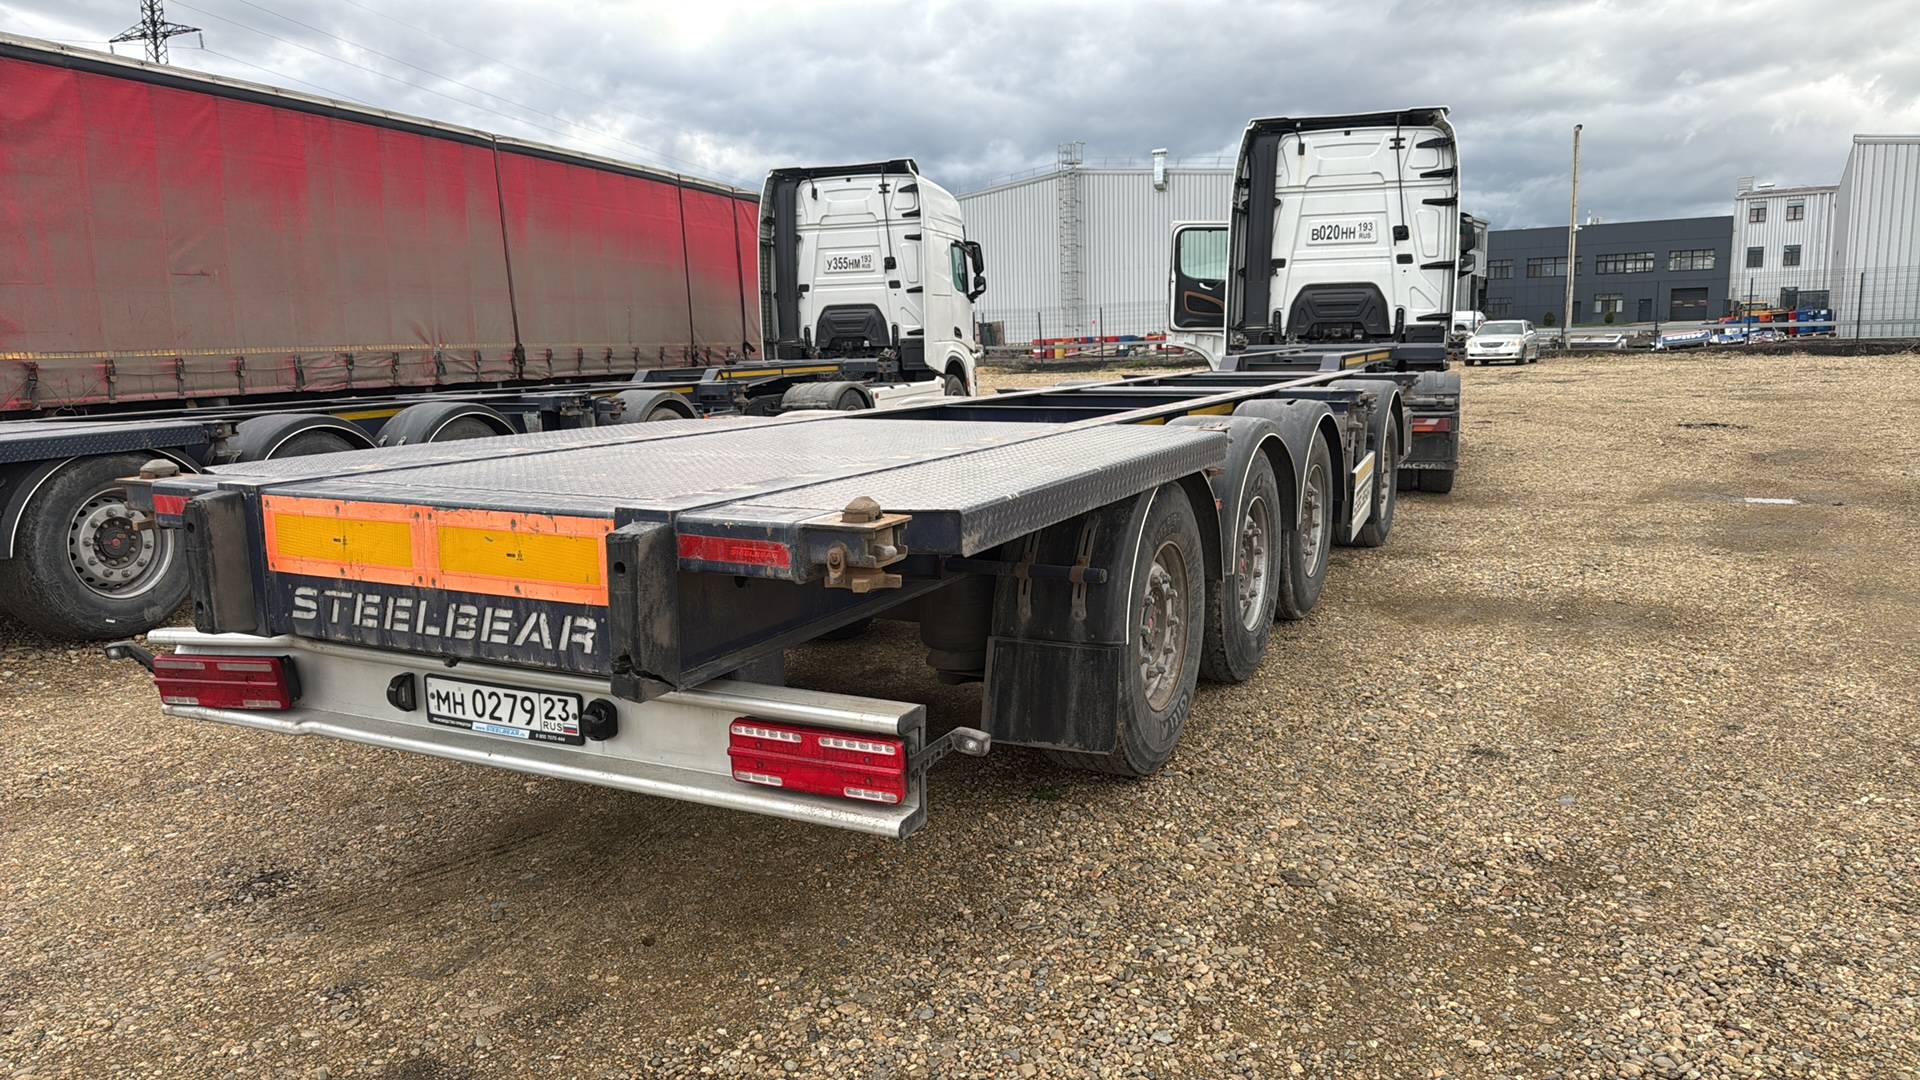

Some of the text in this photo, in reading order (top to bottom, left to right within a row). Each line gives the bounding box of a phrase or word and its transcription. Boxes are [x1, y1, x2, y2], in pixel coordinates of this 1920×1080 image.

[1311, 222, 1373, 241] В020НН 193
[827, 256, 860, 270] У355НМ
[291, 586, 597, 654] STEELBEAR
[435, 688, 570, 726] МН 0279 23
[543, 721, 563, 732] RUS
